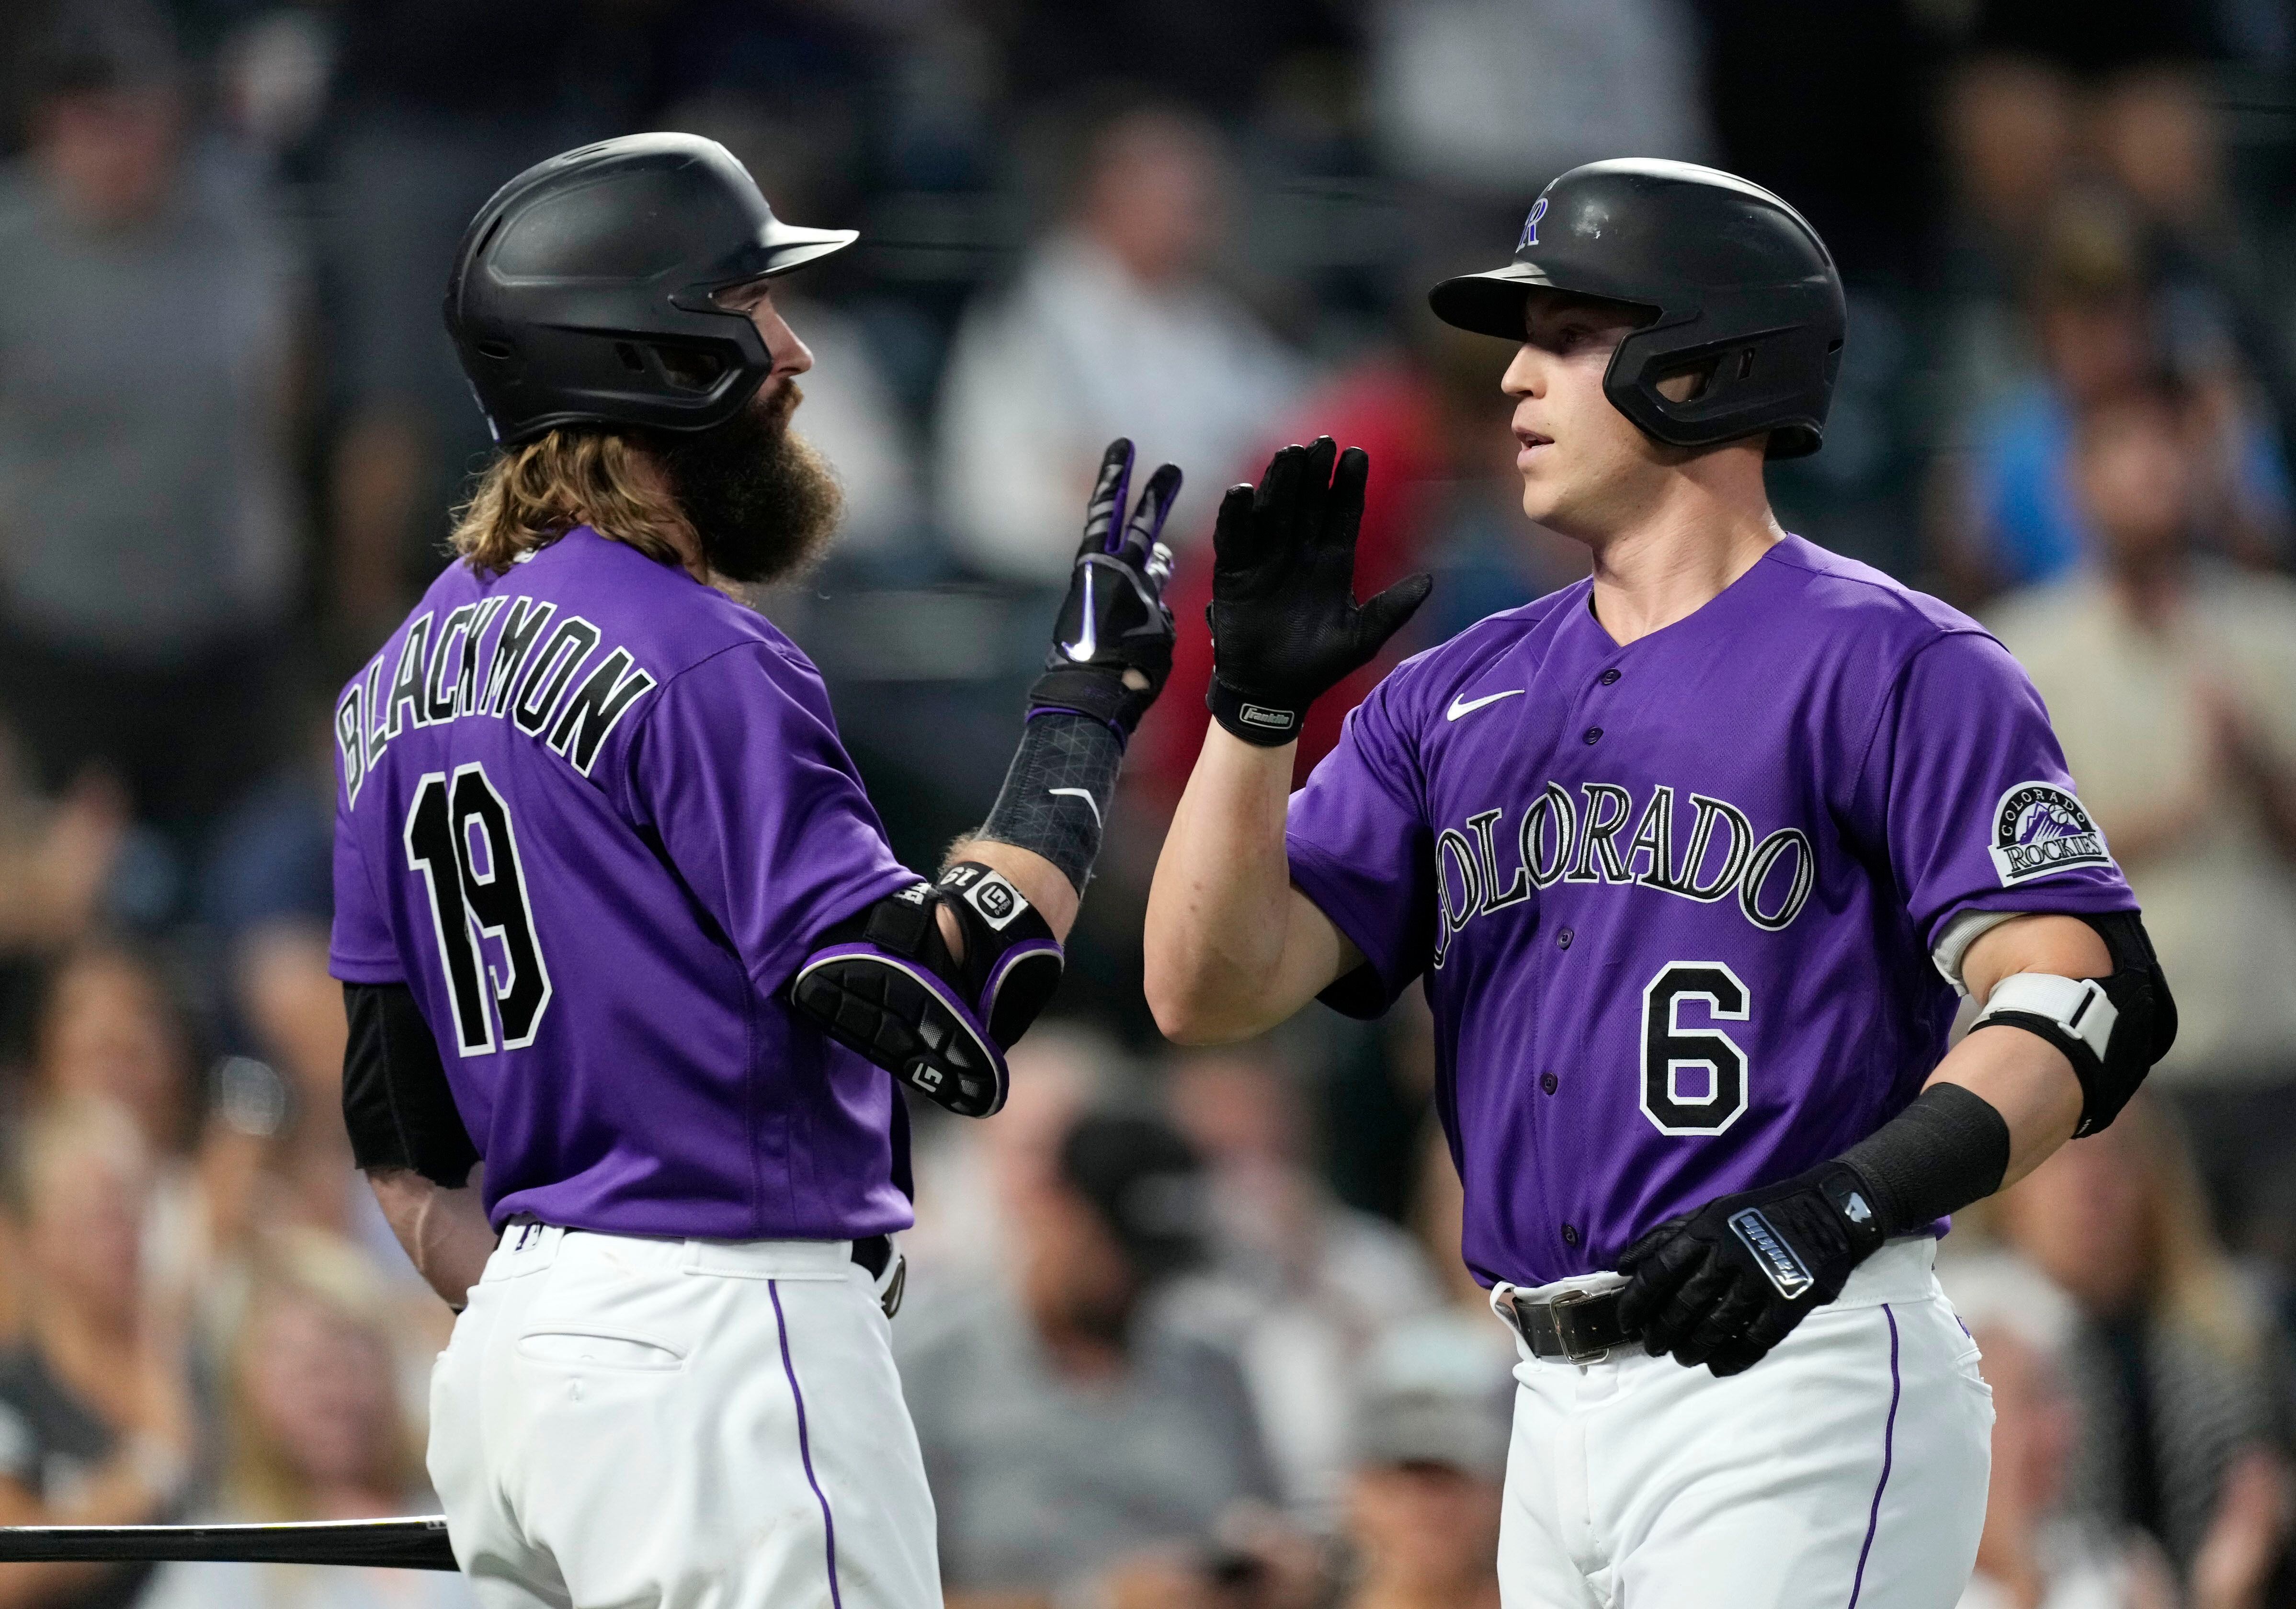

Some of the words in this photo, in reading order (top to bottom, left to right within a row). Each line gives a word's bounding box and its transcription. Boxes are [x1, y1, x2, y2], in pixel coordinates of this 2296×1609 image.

[336, 595, 658, 811] BLACKMON
[1244, 707, 1289, 725] Franklin
[2001, 789, 2086, 837] COLORADO
[2003, 833, 2102, 872] ROCKIES
[403, 761, 553, 1058] 19
[1639, 961, 1750, 1136] 6
[1739, 1215, 1808, 1286] Franklin
